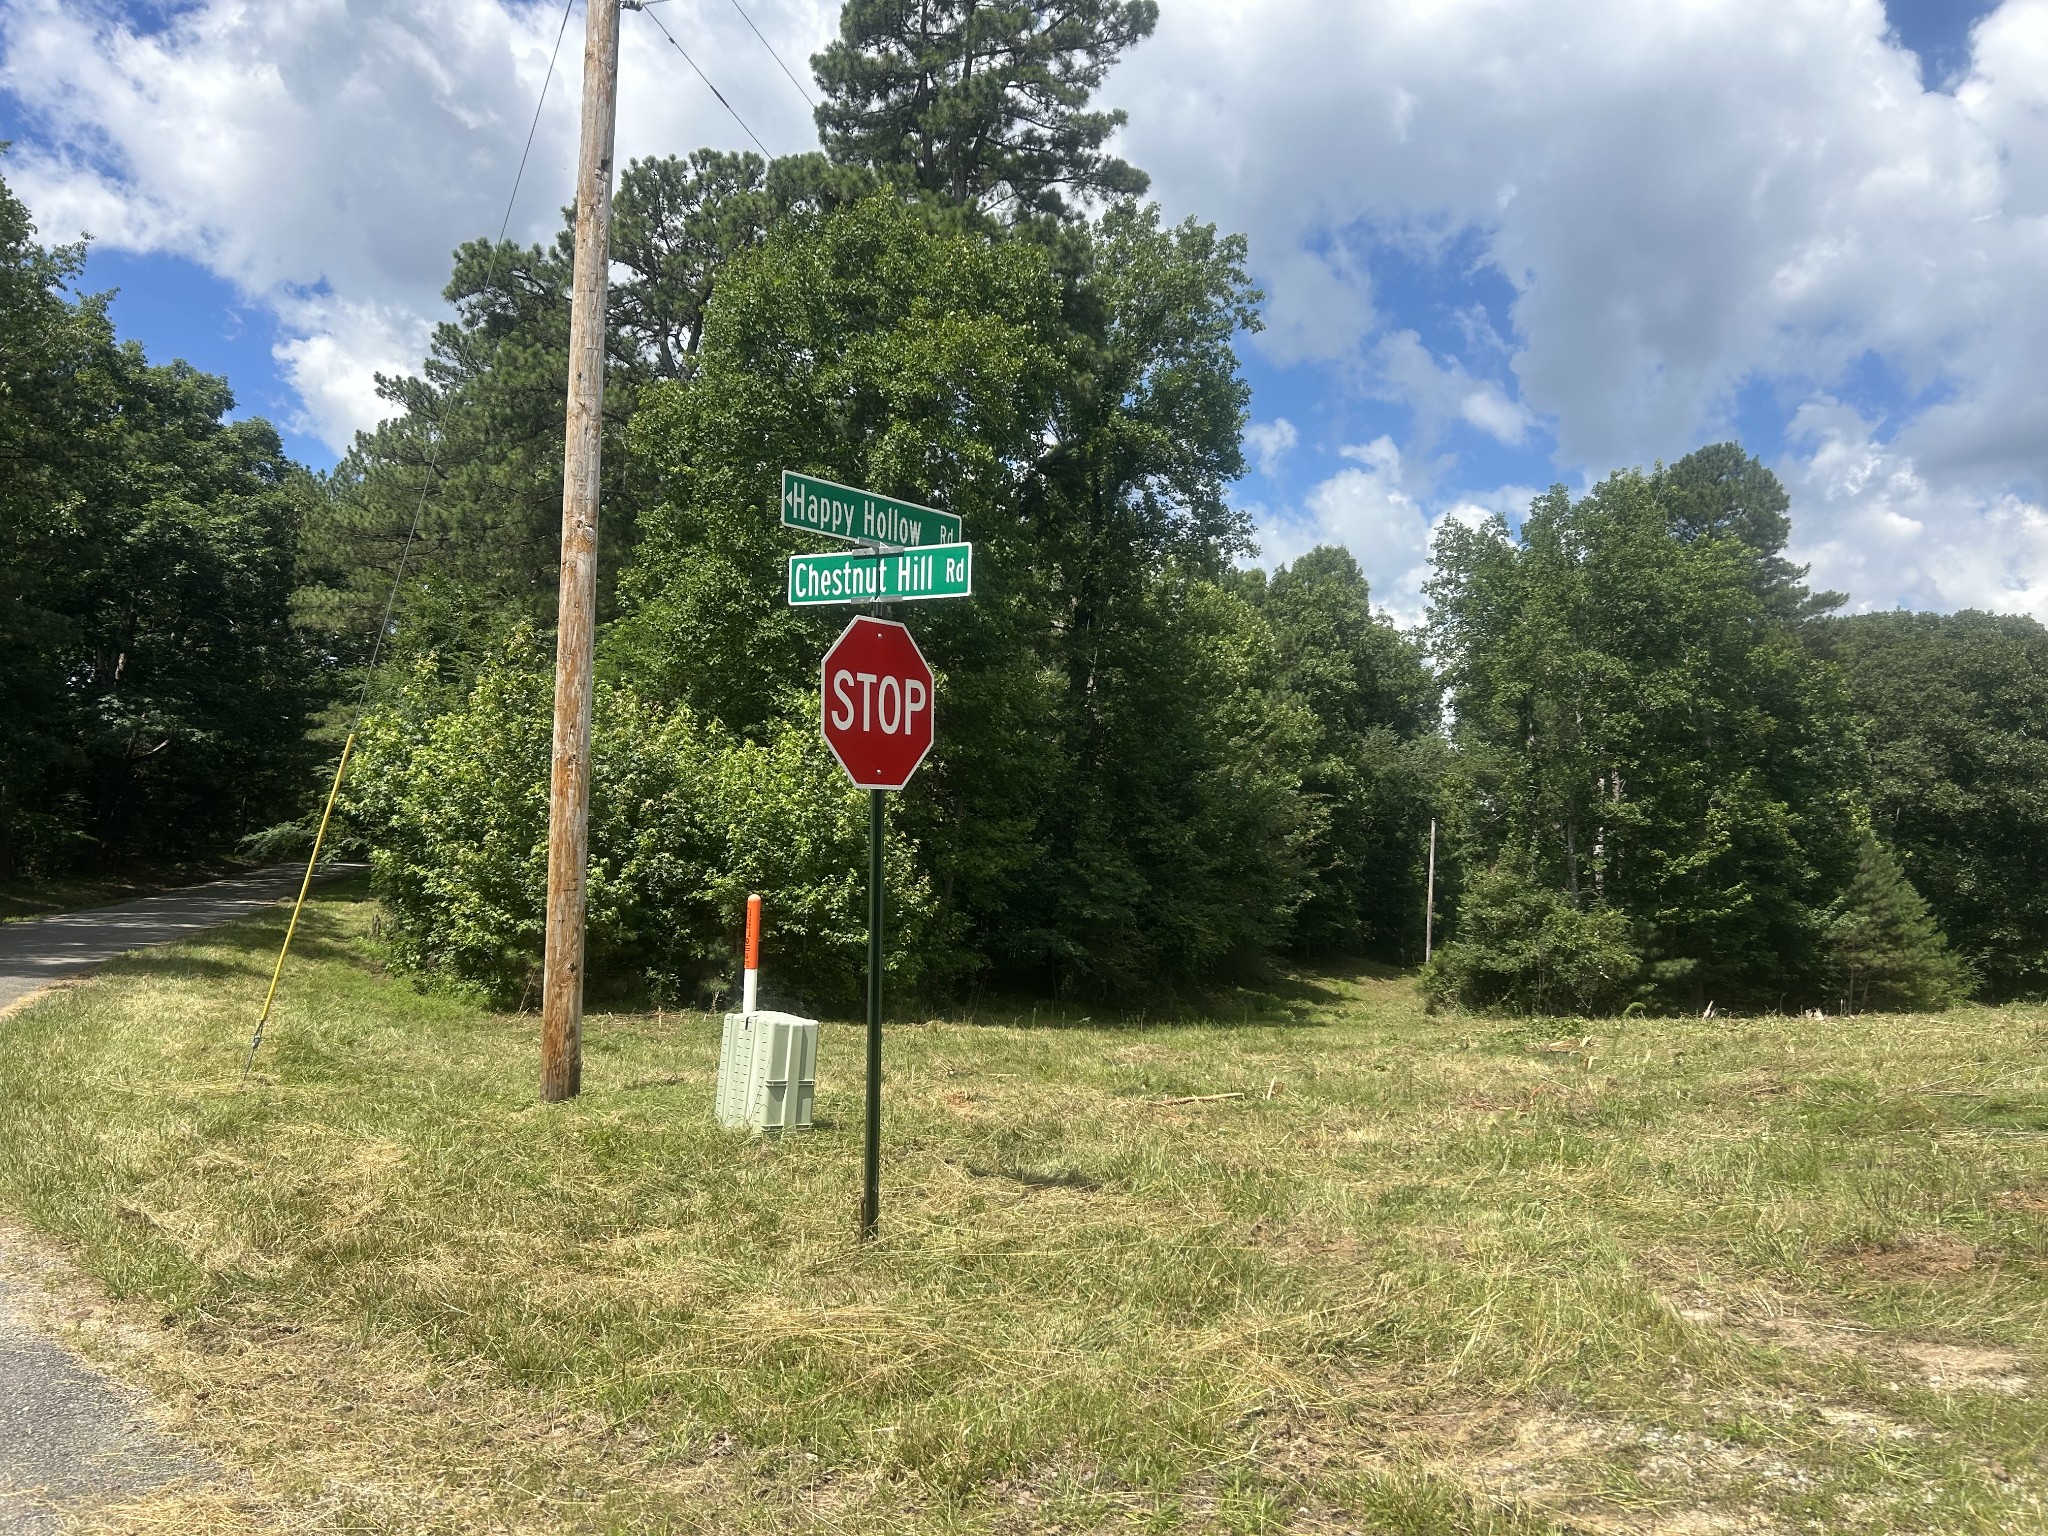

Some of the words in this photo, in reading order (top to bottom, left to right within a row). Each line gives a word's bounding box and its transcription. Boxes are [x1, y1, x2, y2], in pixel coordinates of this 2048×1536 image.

[793, 481, 854, 536] Happy
[863, 500, 922, 545] Hollow
[940, 524, 953, 544] Rd
[795, 561, 888, 597] Chestnut
[897, 555, 933, 592] Hill
[945, 558, 964, 583] Rd
[831, 669, 926, 735] STOP
